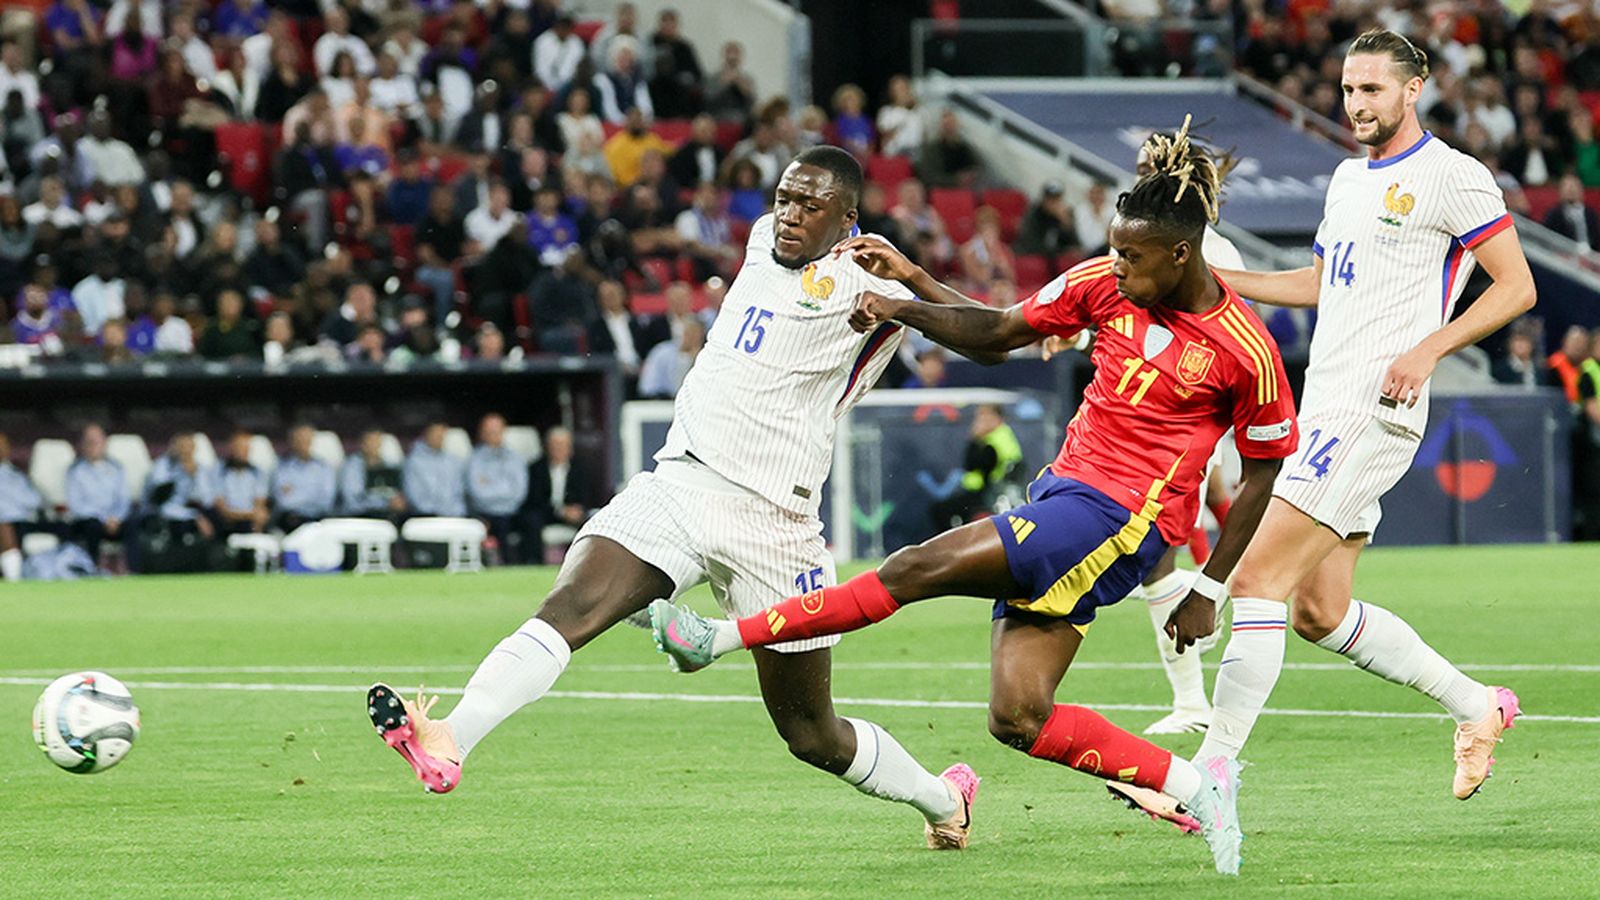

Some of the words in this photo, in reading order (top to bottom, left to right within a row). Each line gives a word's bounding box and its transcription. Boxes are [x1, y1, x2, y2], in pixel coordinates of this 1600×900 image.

[1330, 241, 1355, 286] 14
[734, 306, 774, 353] 15
[1115, 357, 1160, 406] 11
[1300, 429, 1340, 478] 14
